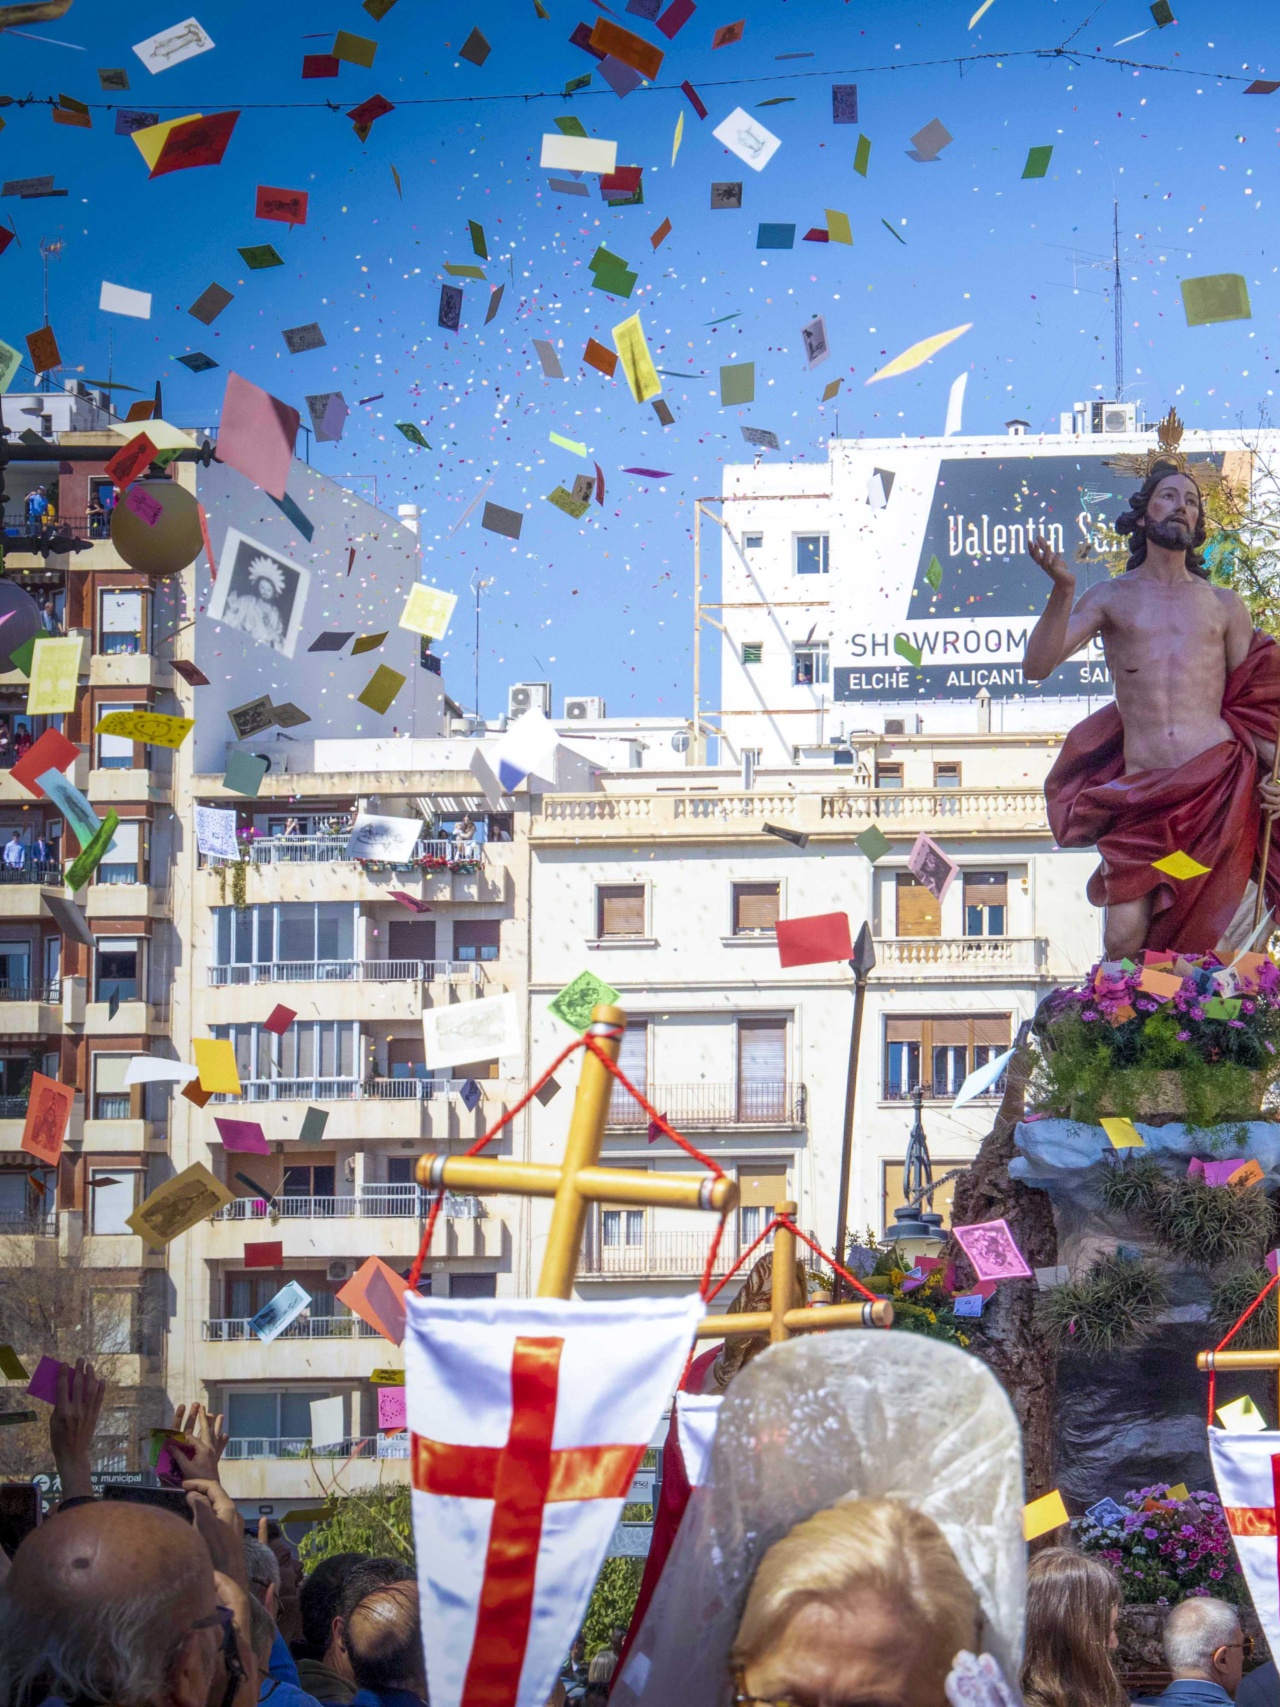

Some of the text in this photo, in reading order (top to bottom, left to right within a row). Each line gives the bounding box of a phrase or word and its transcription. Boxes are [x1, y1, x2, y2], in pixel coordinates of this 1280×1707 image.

[948, 515, 1065, 556] Valentín
[851, 629, 1028, 657] SHOWROOM
[849, 667, 1110, 689] ELCHE ALICANT SA
[101, 1474, 142, 1484] municipal
